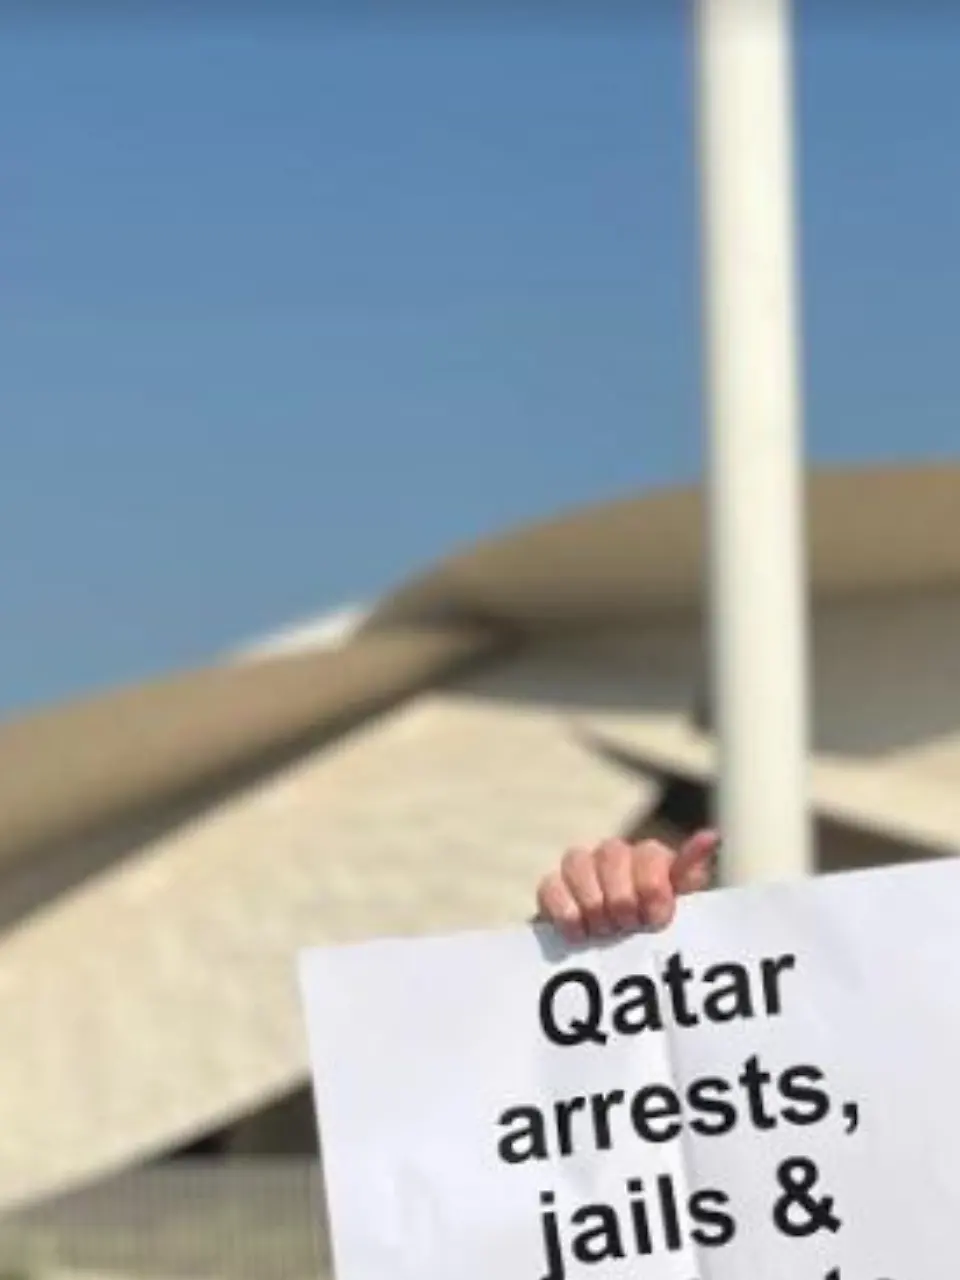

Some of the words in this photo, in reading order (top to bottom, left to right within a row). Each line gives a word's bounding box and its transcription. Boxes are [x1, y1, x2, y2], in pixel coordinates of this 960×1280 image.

[538, 952, 796, 1047] Qatar
[497, 1054, 859, 1165] arrests,
[772, 1156, 842, 1238] &
